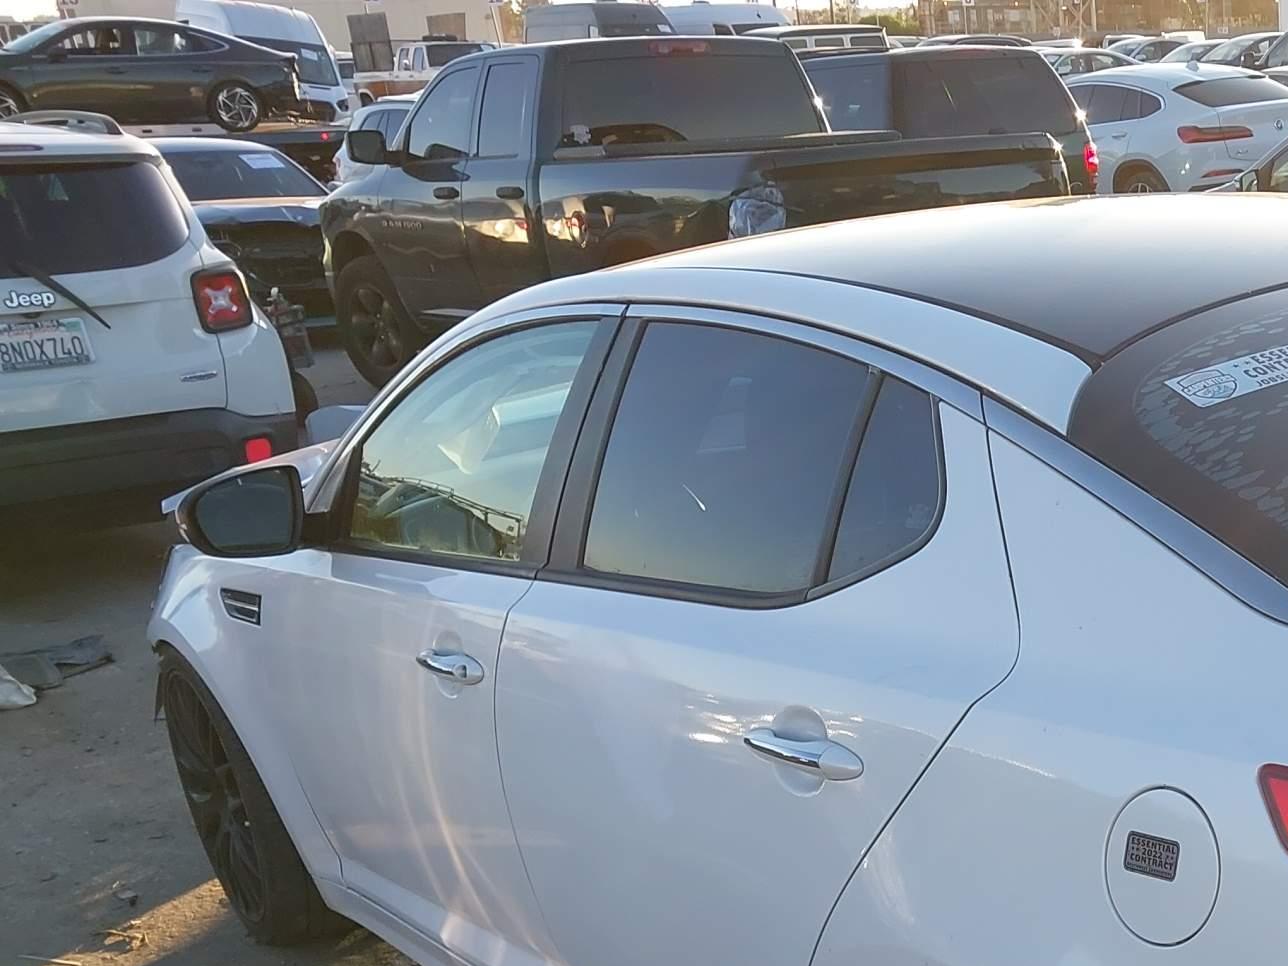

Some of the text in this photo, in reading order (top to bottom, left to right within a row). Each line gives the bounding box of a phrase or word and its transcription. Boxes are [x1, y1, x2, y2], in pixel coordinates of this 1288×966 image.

[4, 290, 55, 308] Jeep
[1256, 374, 1288, 387] JOBS!
[1131, 836, 1176, 855] ESSENTIAL
[1141, 847, 1163, 860] 2022
[1130, 852, 1174, 871] CONTRACT
